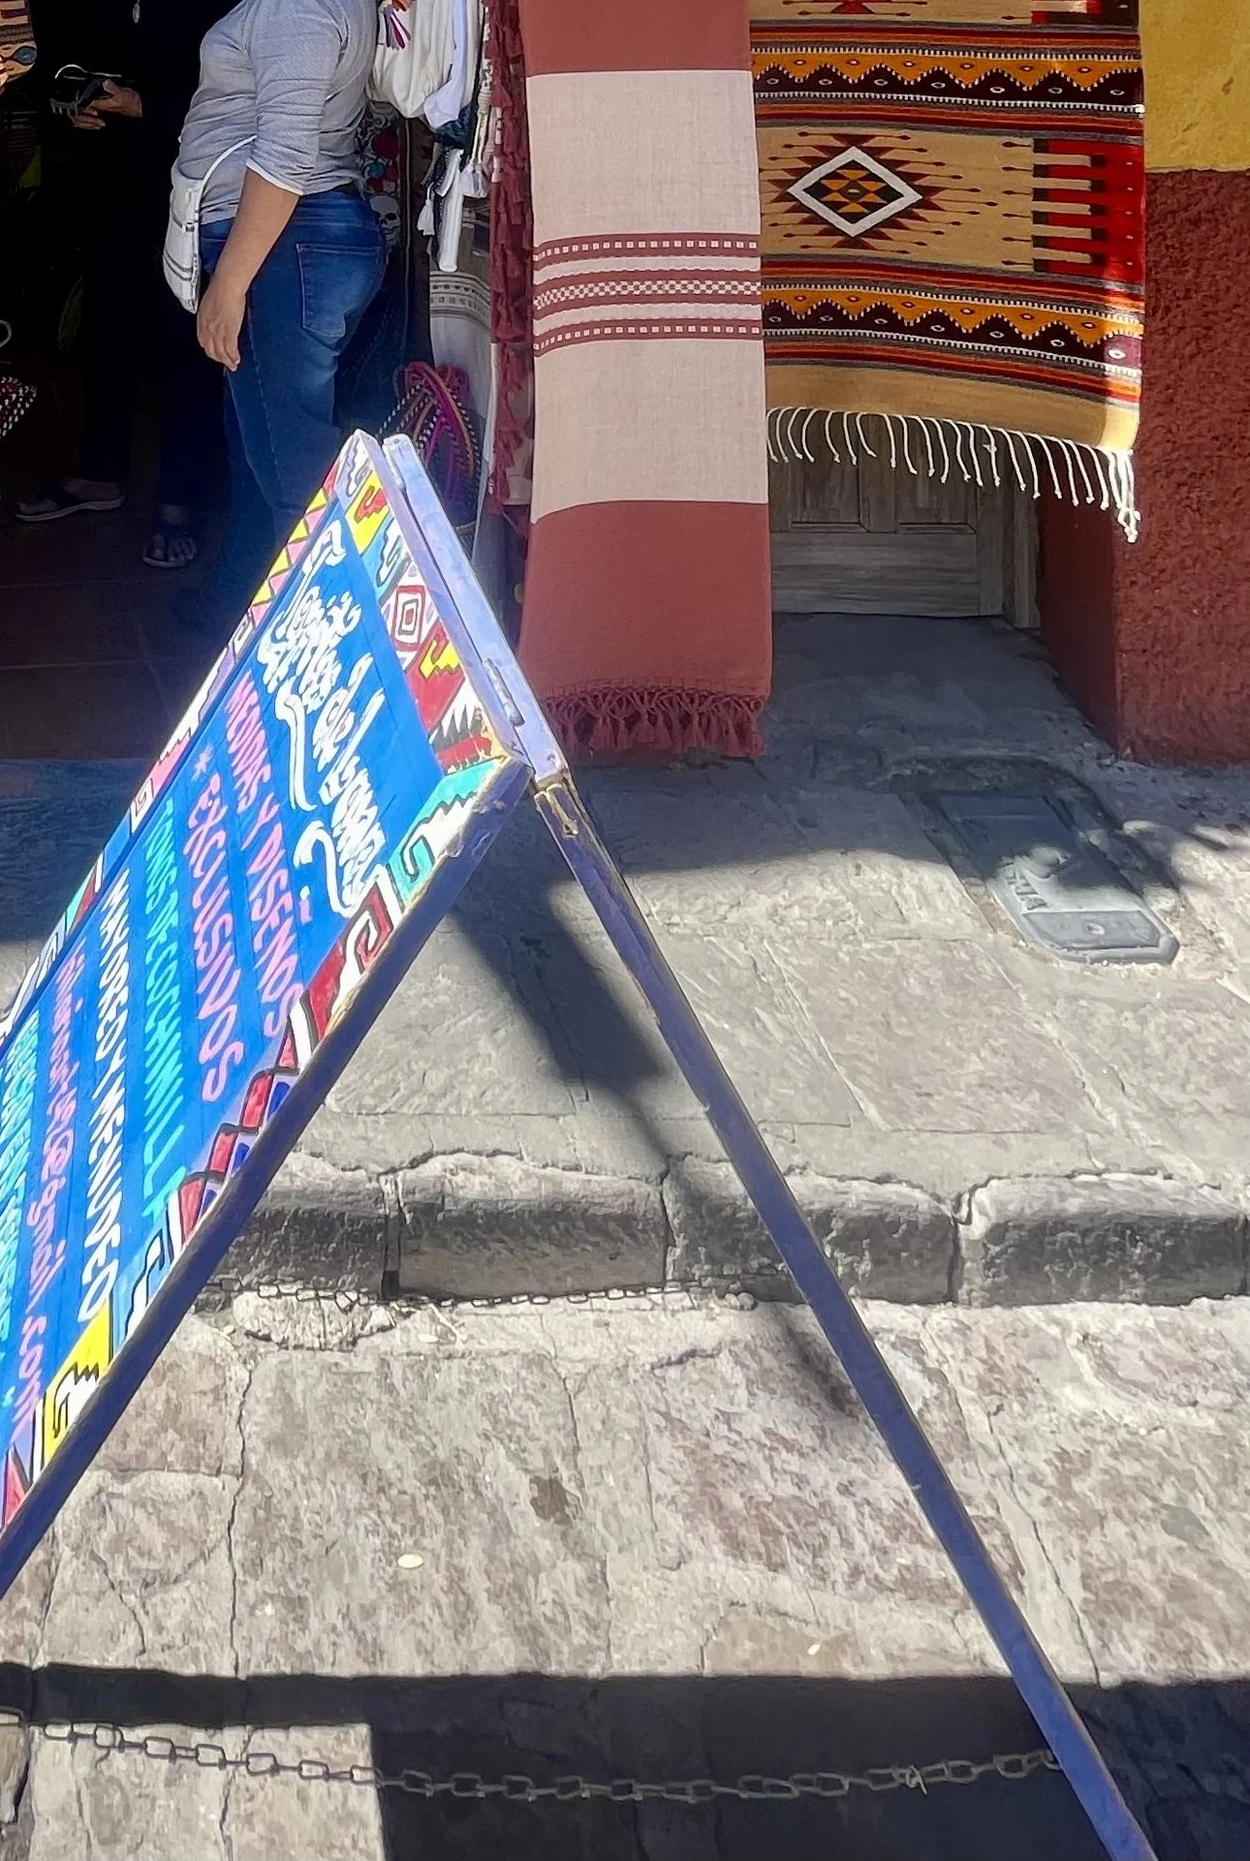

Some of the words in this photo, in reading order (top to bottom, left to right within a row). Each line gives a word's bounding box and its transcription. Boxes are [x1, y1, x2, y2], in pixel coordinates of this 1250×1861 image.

[227, 670, 271, 815] MEDIDAS
[241, 792, 280, 851] Y
[144, 797, 178, 915] TONOS
[145, 891, 179, 965] DE
[185, 775, 244, 1102] EXCLUSIVOS
[247, 819, 311, 1036] DISEÑOS
[96, 868, 130, 1062] MAYOREO
[91, 1037, 126, 1100] Y
[142, 940, 188, 1222] COCHINILLA
[77, 1070, 125, 1321] MENUDEO
